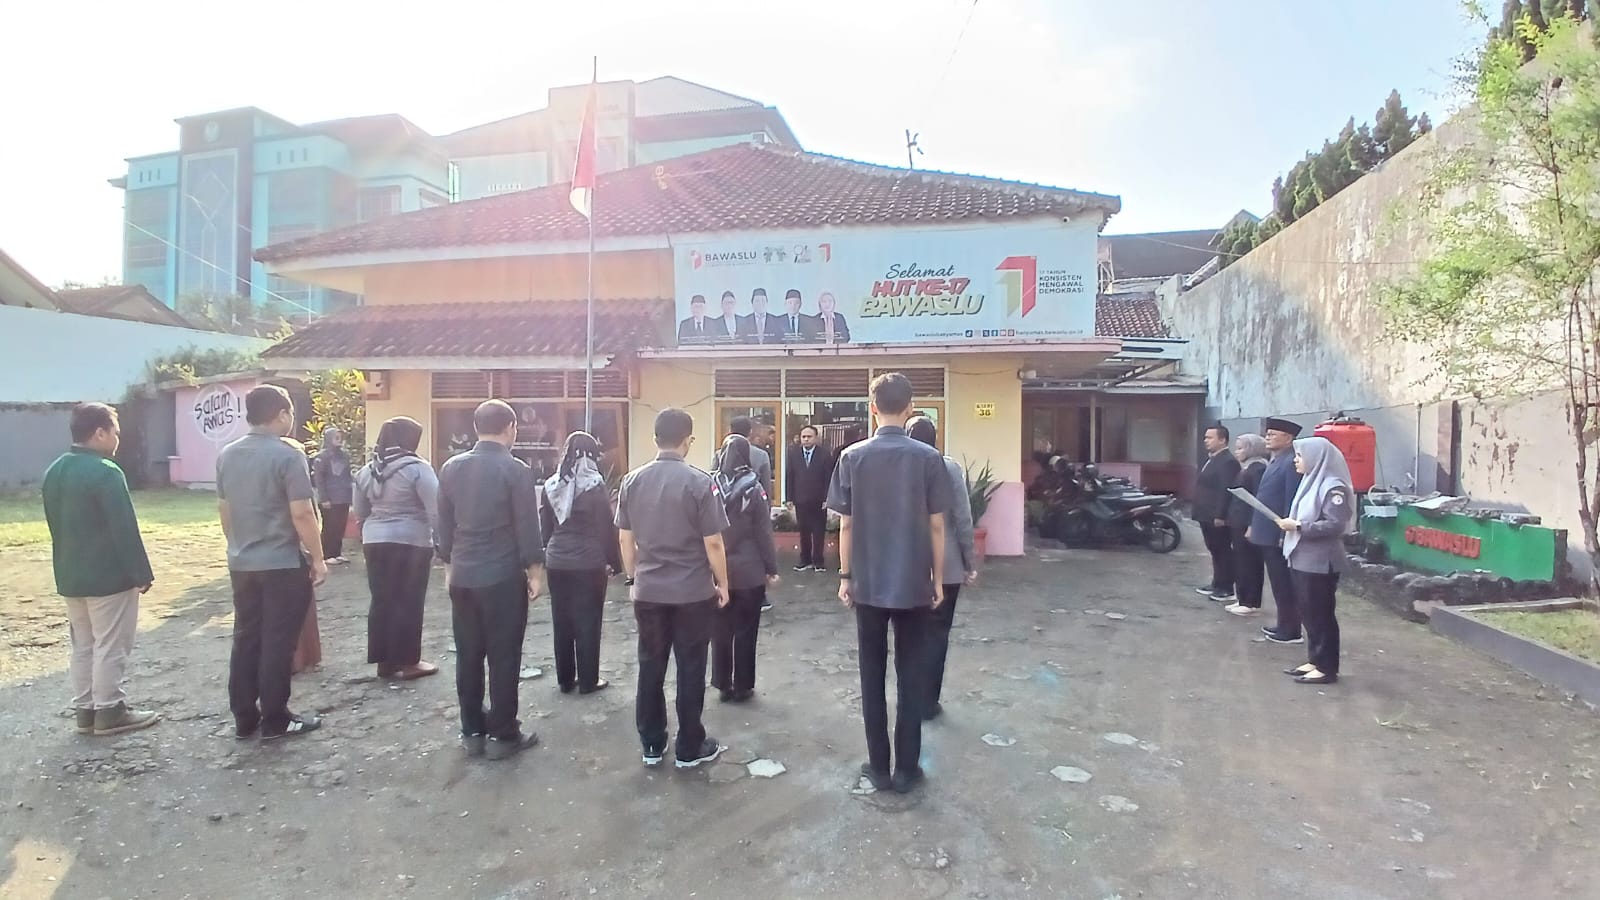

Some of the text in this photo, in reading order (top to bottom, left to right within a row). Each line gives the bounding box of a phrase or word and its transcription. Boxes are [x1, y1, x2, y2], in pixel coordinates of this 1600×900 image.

[705, 251, 757, 262] BAWASLU
[885, 262, 954, 279] Selamat
[871, 279, 916, 298] HUT
[860, 295, 985, 318] BAWASLU
[1415, 526, 1481, 559] BAWASLU
